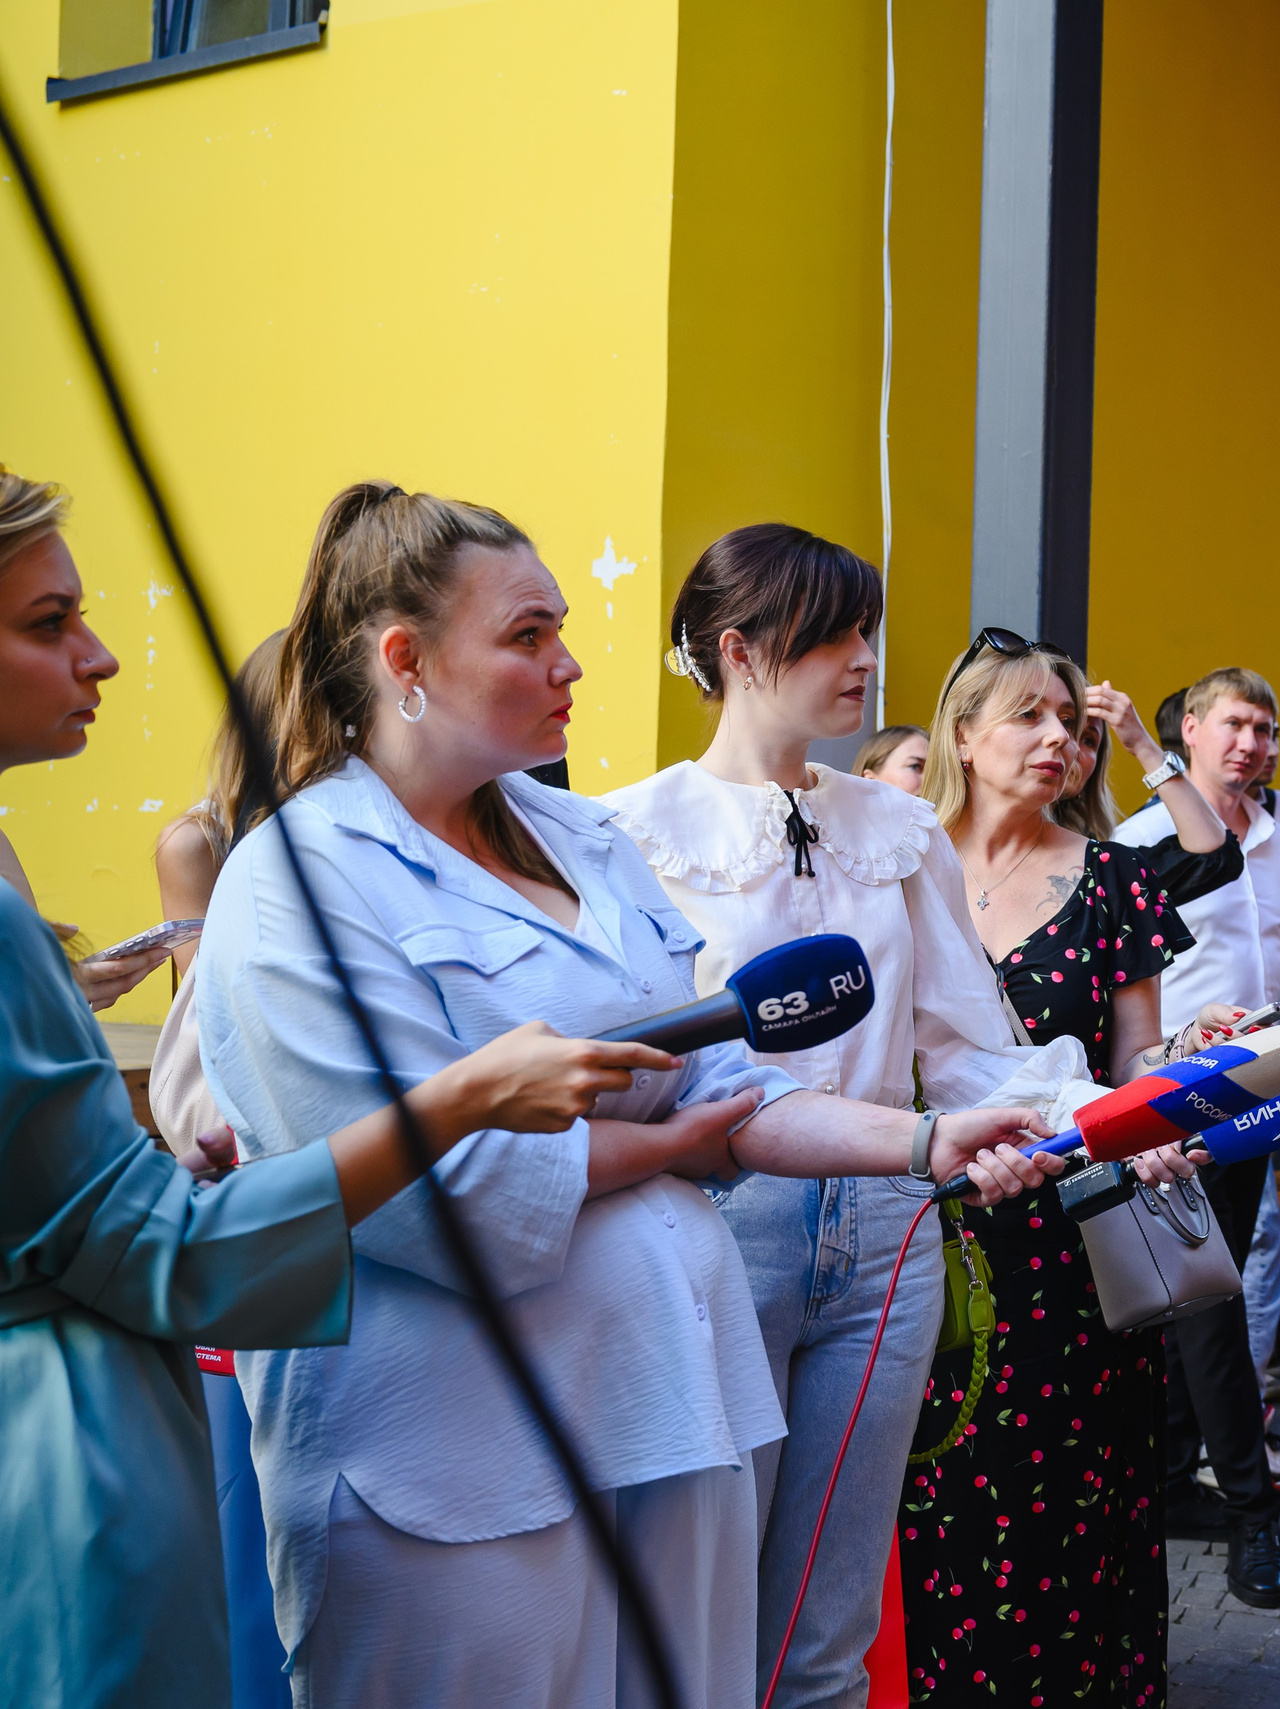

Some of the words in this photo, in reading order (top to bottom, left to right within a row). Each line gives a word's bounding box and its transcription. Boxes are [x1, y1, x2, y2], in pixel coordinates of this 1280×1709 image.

[757, 990, 810, 1021] 63
[829, 965, 866, 999] RU
[761, 1019, 800, 1031] САМАРА
[801, 1005, 837, 1023] ОНЛАЙН
[1185, 1091, 1233, 1121] РОССИЯ
[195, 1352, 222, 1362] СТЕМА
